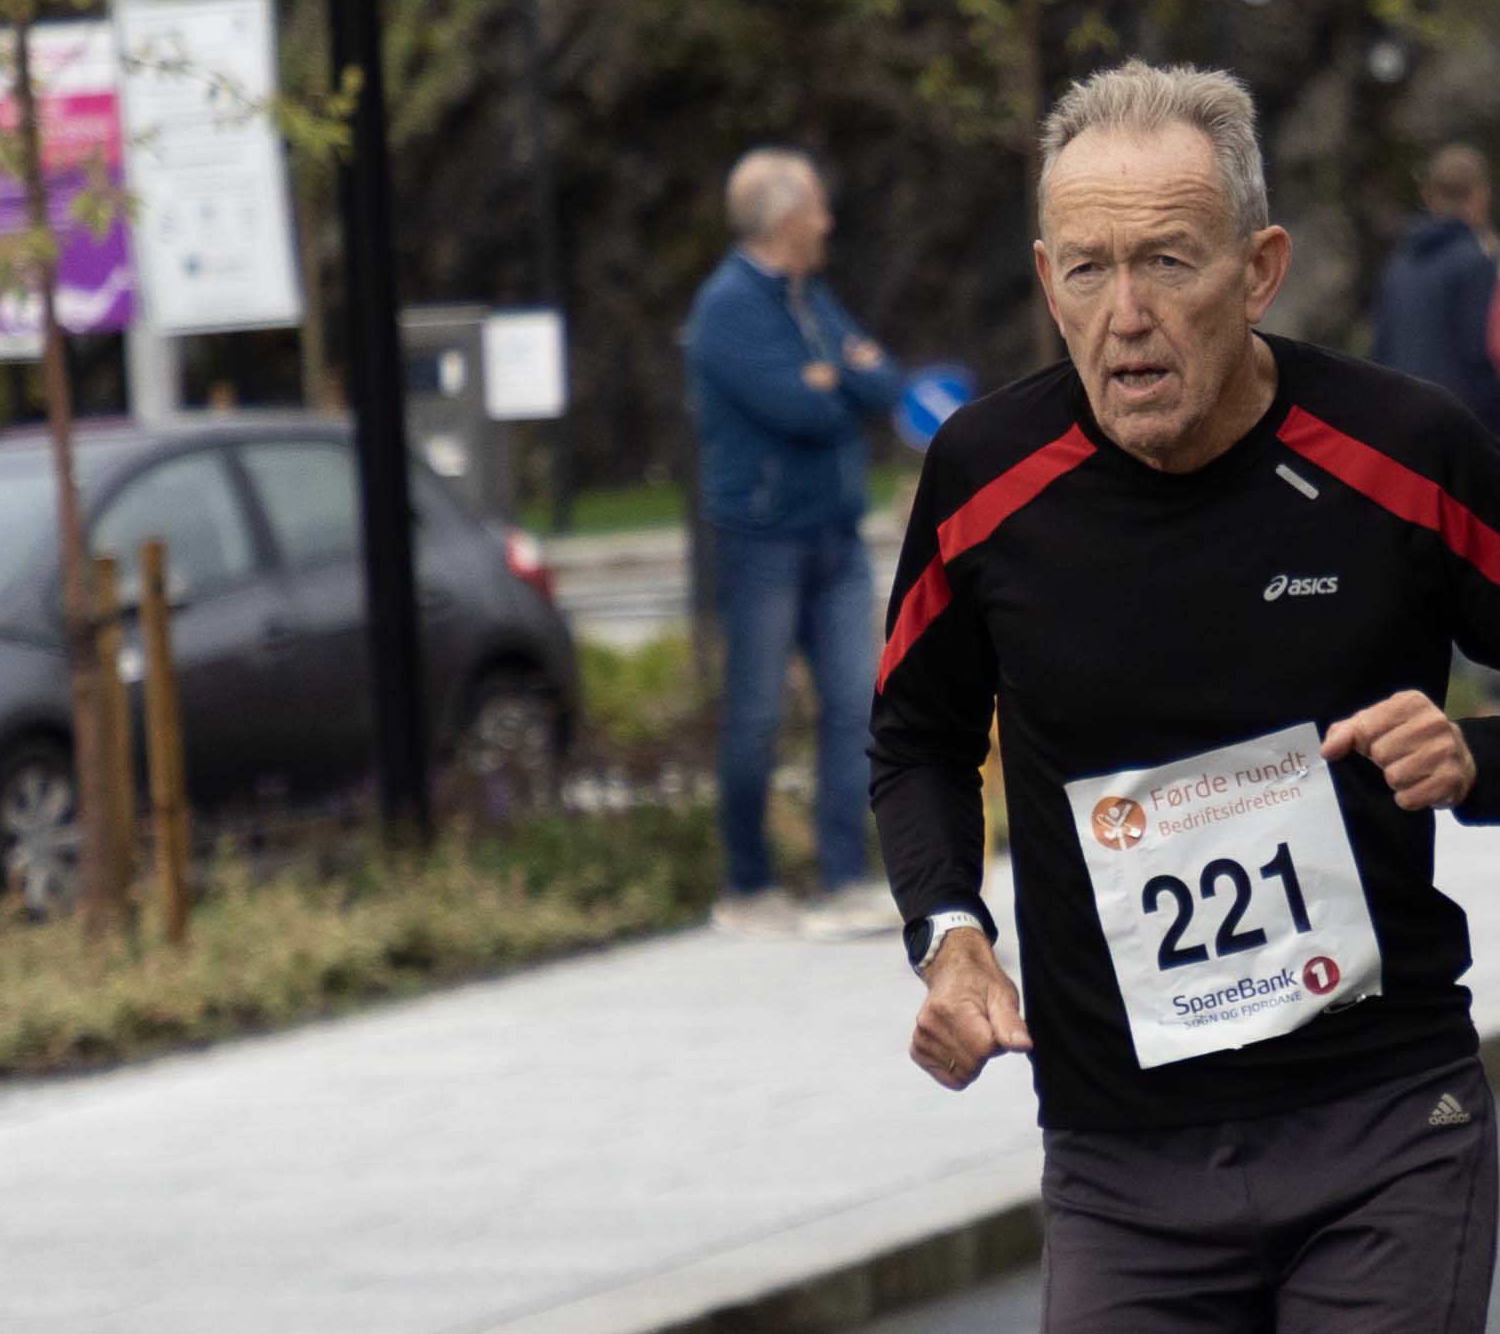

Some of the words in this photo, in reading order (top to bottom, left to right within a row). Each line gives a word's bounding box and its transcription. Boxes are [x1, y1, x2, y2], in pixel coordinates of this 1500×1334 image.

[1287, 576, 1339, 596] asics
[1150, 773, 1228, 812] Førde
[1158, 786, 1302, 837] Bedriftsidretten
[1141, 841, 1313, 972] 221
[1172, 968, 1299, 1017] SpareBank
[1220, 1008, 1239, 1022] OG
[1242, 991, 1303, 1016] FJORDANE
